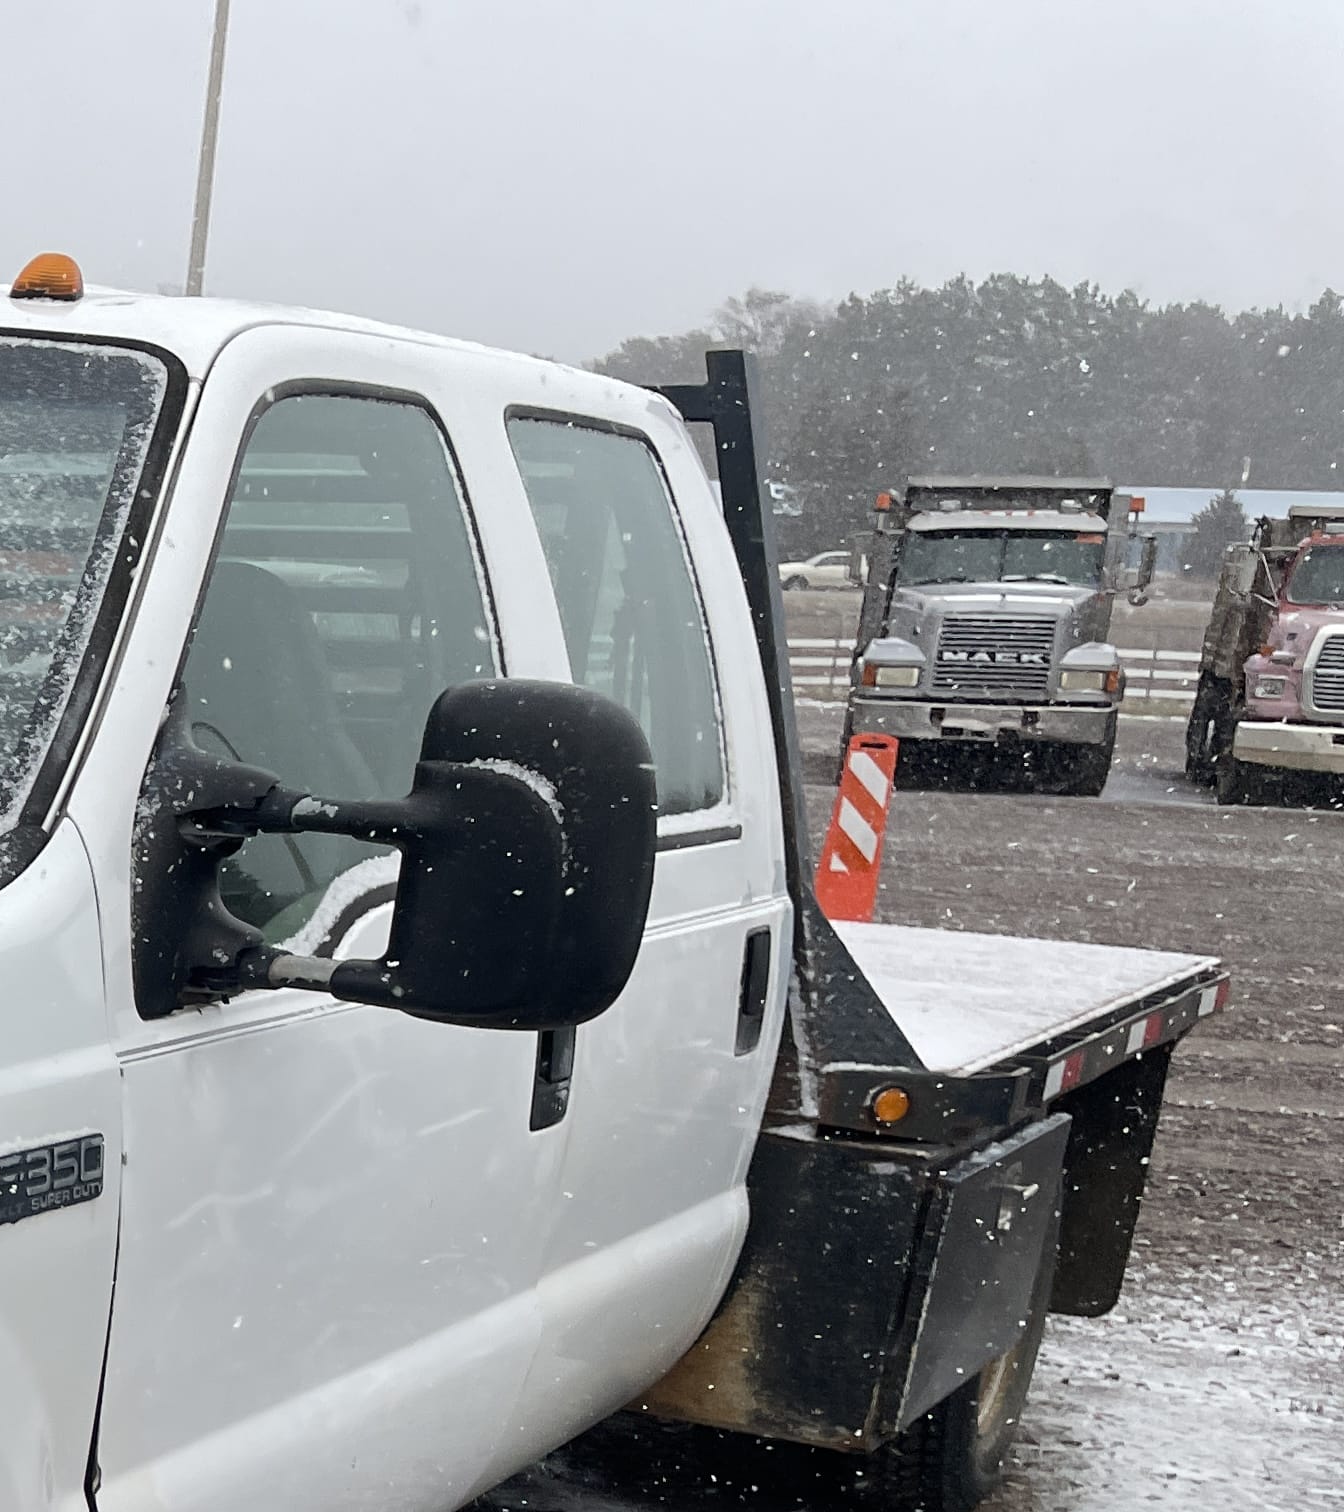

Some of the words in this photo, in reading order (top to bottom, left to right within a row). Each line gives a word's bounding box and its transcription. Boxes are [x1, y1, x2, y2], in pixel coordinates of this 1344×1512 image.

[943, 651, 1044, 664] MACK
[31, 1189, 71, 1211] SUPER
[73, 1181, 103, 1200] DUTY
